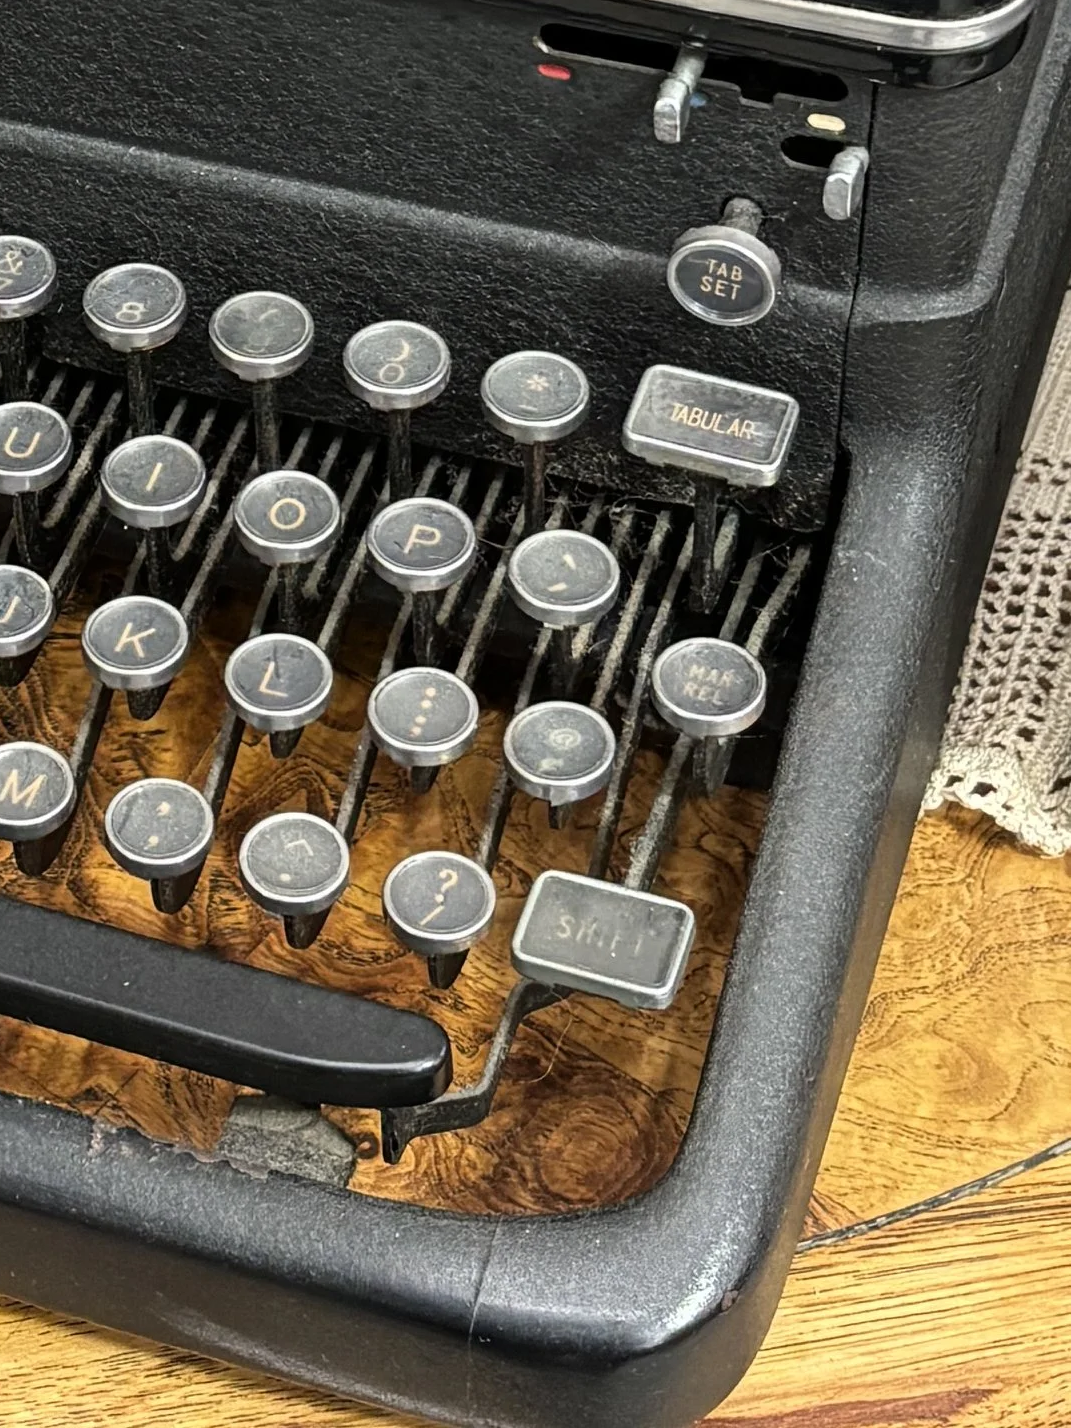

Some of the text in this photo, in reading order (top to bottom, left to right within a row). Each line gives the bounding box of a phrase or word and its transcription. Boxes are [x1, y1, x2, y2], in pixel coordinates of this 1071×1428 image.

[707, 258, 744, 281] TAB
[699, 275, 741, 300] SET
[115, 302, 147, 323] 8
[670, 402, 756, 440] TABULAR
[4, 426, 42, 458] U
[268, 497, 307, 530] O
[403, 523, 441, 555] P
[114, 622, 156, 657] K
[259, 661, 288, 698] L
[438, 868, 460, 904] ?
